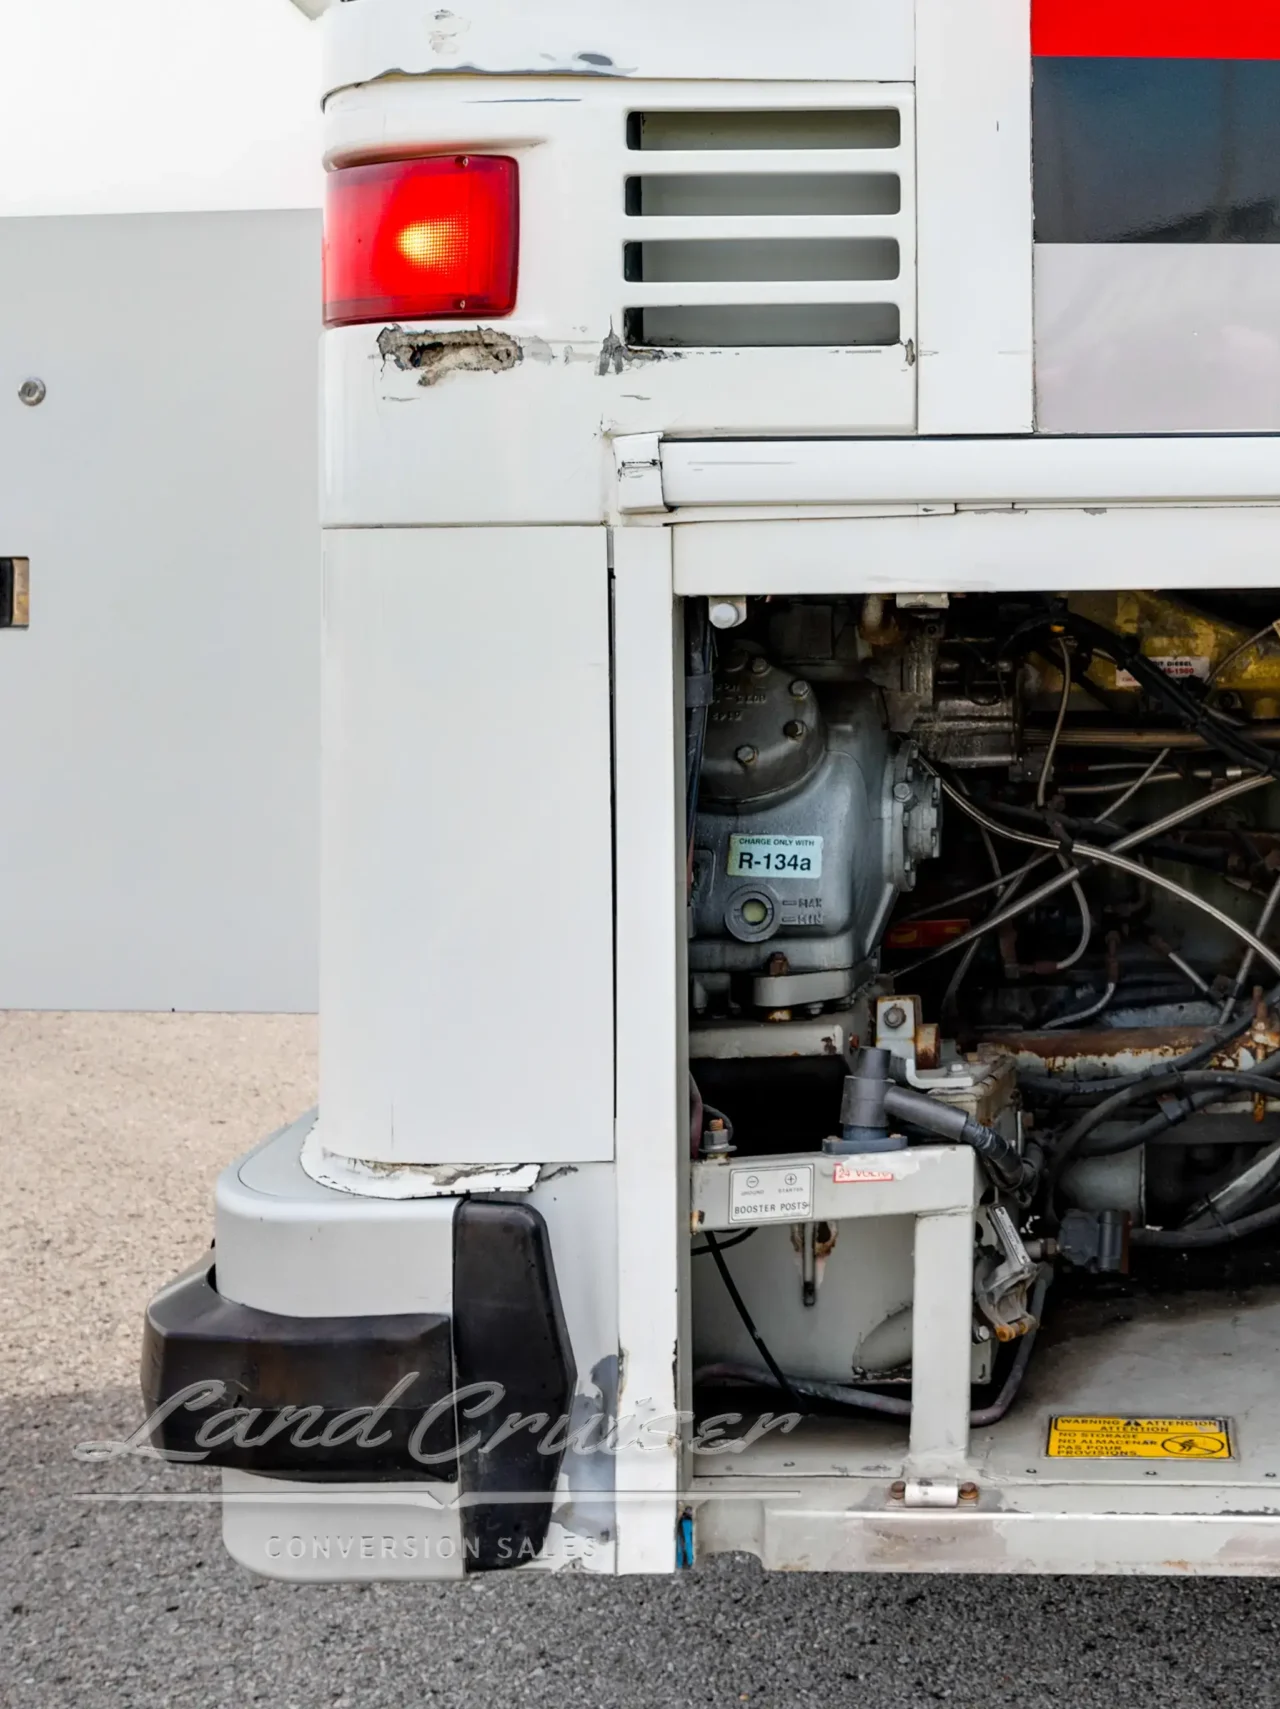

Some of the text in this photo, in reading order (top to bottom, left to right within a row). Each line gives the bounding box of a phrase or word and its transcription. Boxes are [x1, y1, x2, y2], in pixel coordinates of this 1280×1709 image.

[738, 837, 815, 847] CHARGE ONLY WITH
[738, 851, 812, 872] R-134a
[734, 1203, 776, 1215] BOOSTER
[780, 1200, 808, 1211] POSTS
